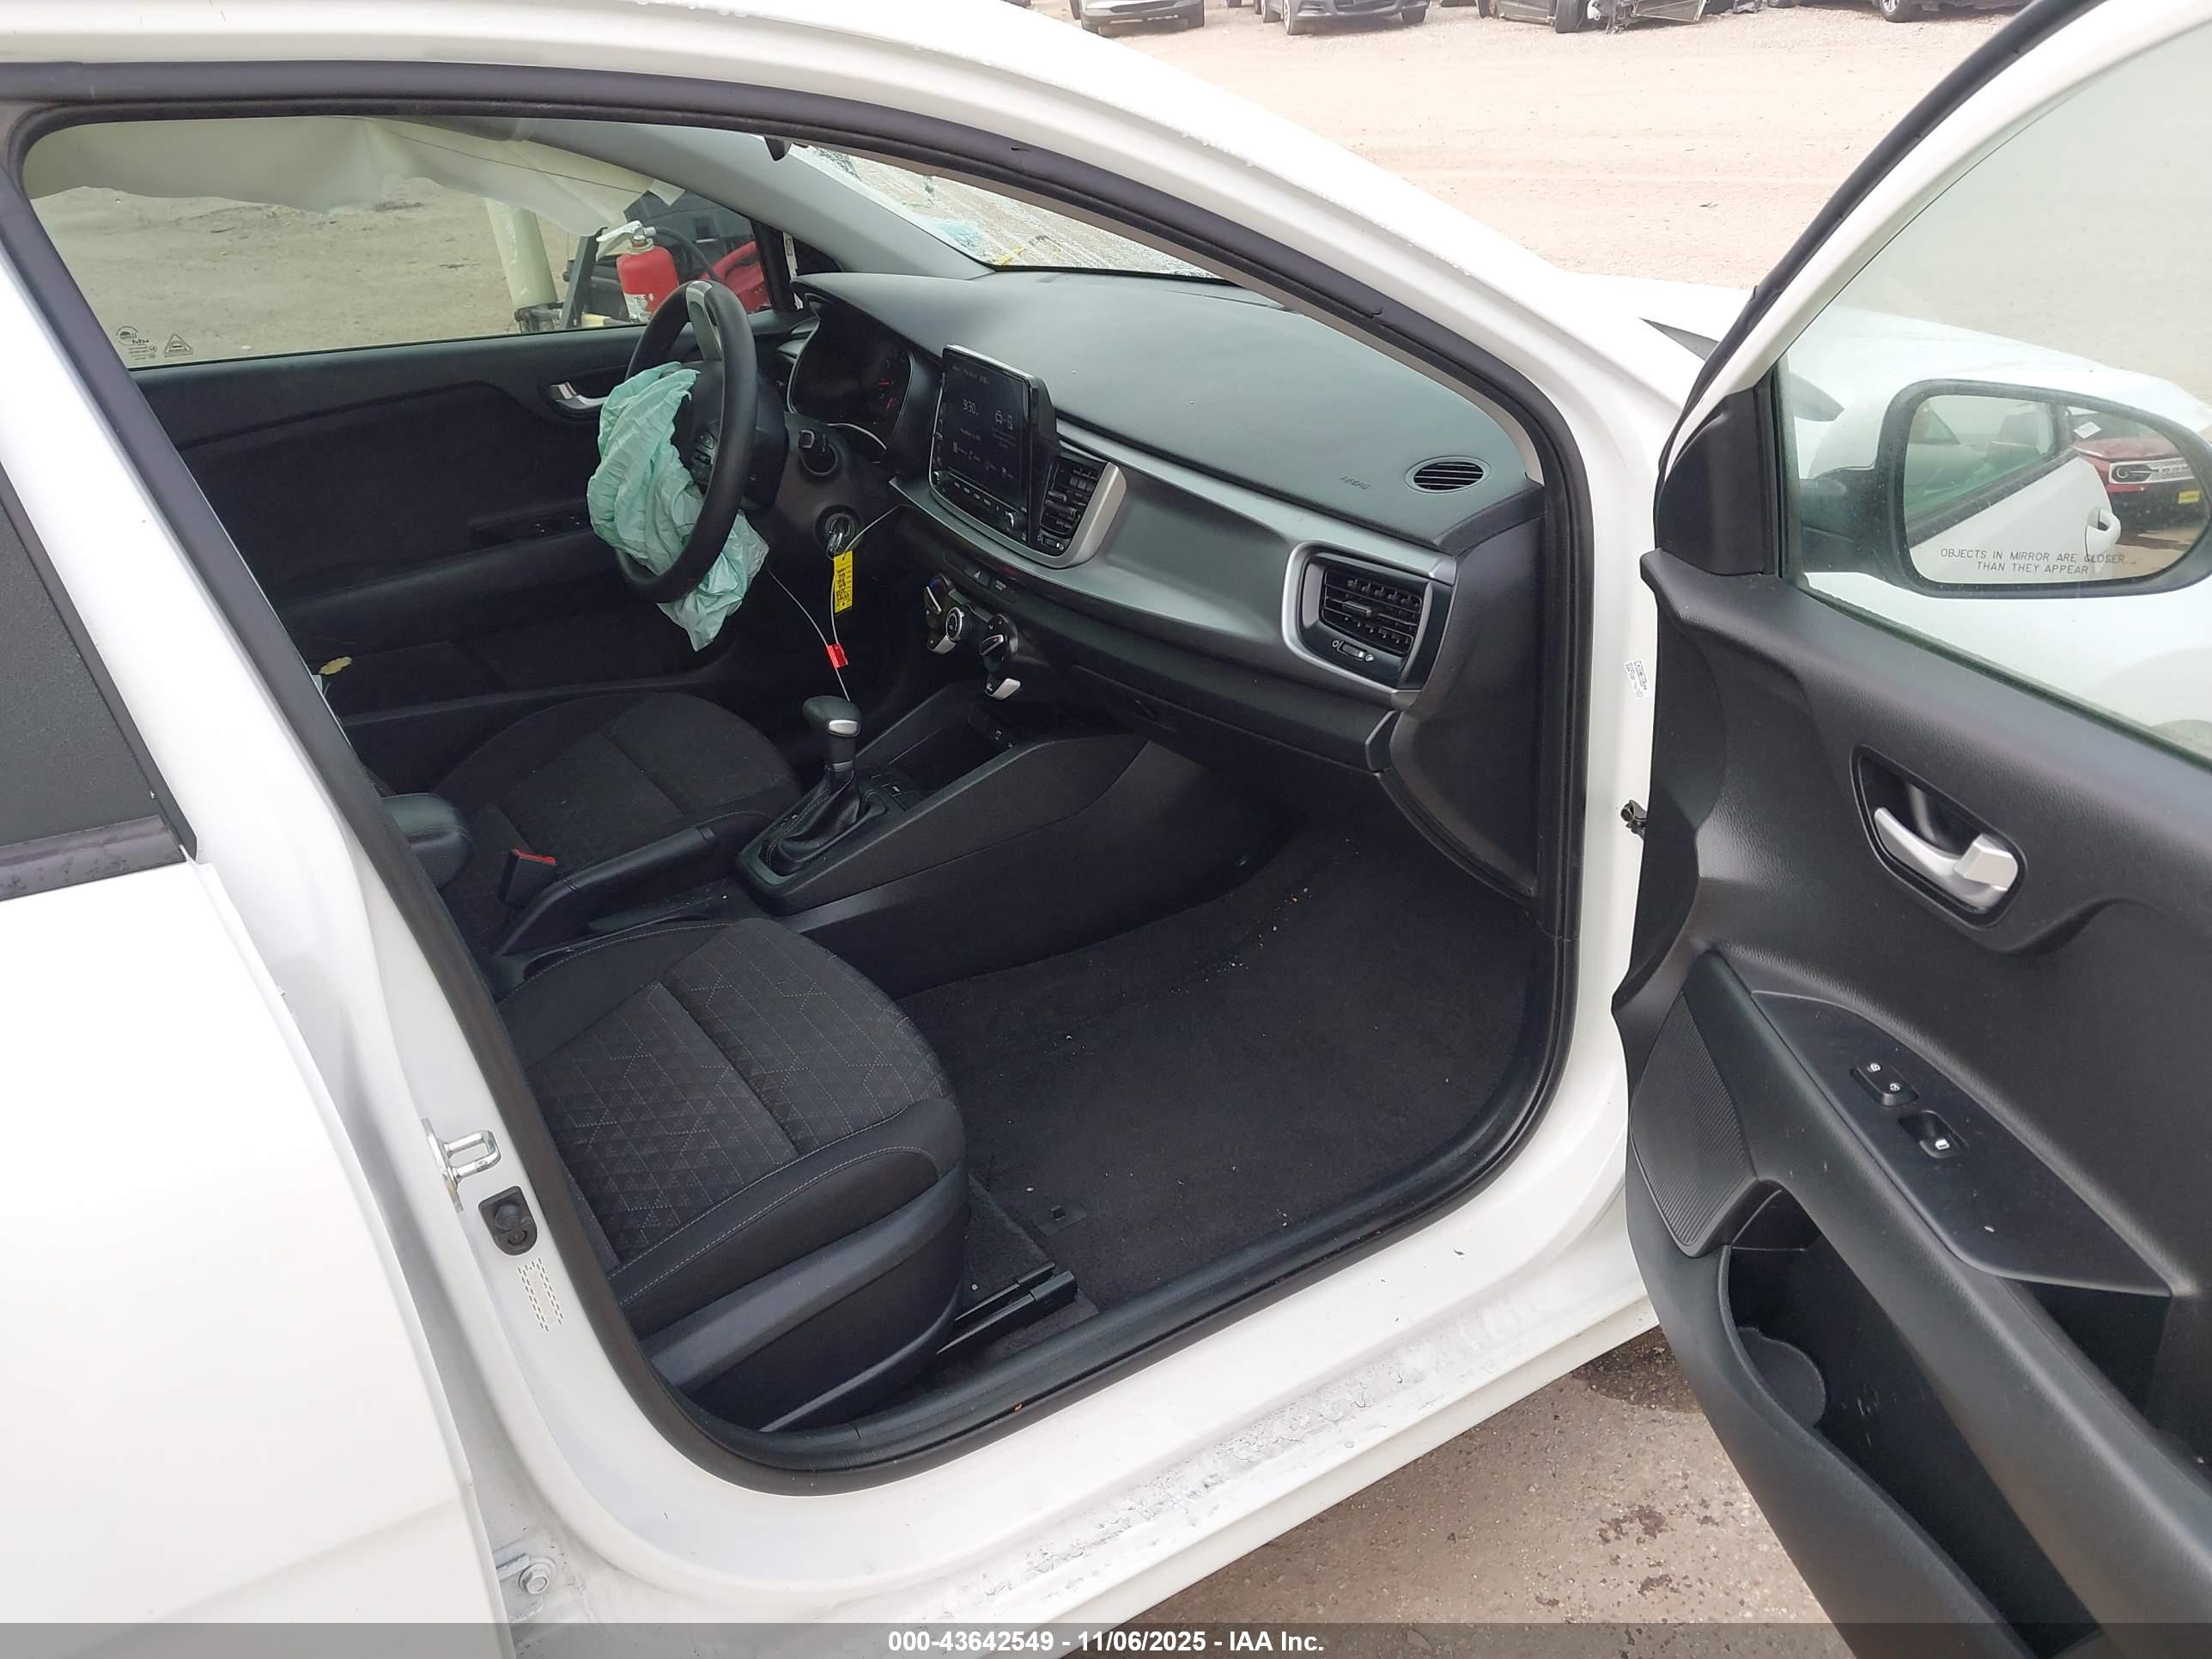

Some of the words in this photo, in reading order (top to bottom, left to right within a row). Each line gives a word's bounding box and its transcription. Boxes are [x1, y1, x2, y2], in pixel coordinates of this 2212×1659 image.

[1941, 548, 1986, 559] OBJECTS
[1992, 549, 2002, 560] IN
[2010, 550, 2050, 562] MIRROR
[2056, 552, 2078, 563] ARE
[2084, 553, 2125, 564] CLOSER
[1977, 562, 2005, 571] THAN
[2012, 563, 2039, 574] THEY
[2044, 564, 2089, 574] APPEAR
